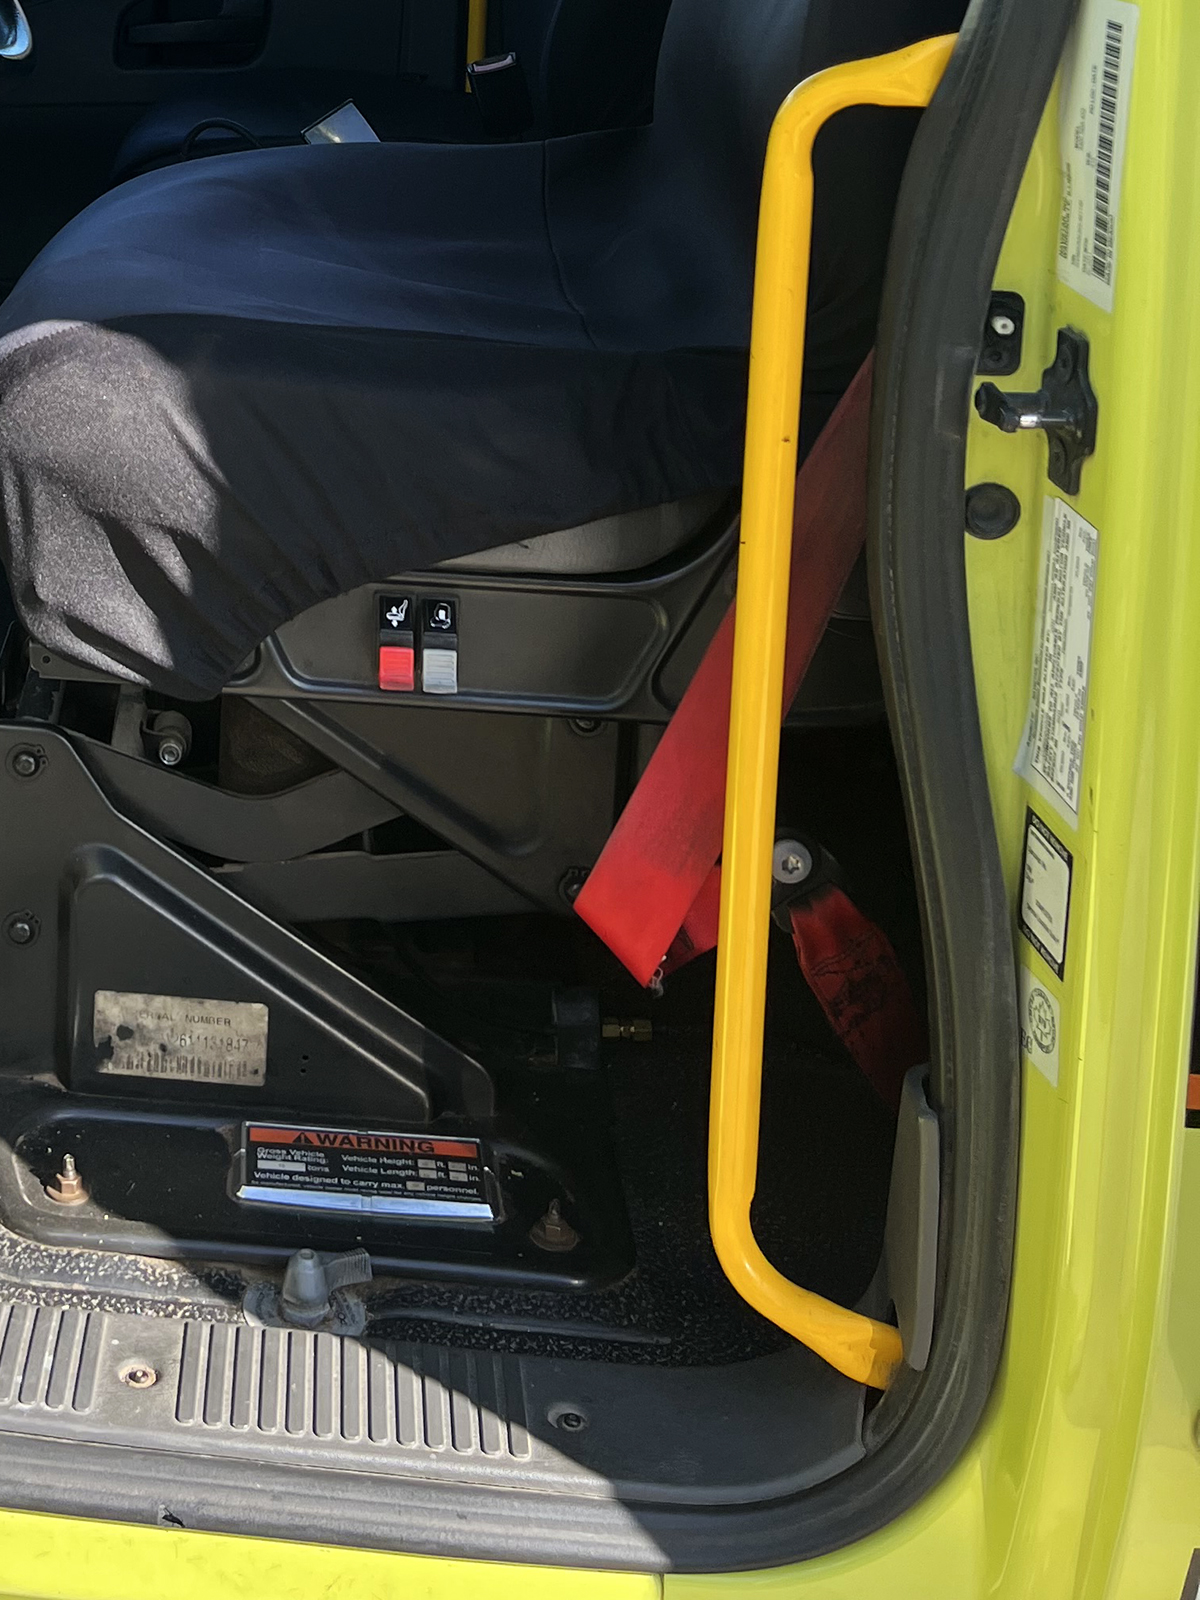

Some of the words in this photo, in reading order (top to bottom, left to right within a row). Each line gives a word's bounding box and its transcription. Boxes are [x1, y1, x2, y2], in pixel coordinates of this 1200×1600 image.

[184, 1013, 232, 1027] NUMBER
[317, 1133, 435, 1153] WARNING
[257, 1146, 287, 1155] Gross
[289, 1148, 325, 1157] Vehicle
[341, 1154, 378, 1164] Vehicle
[380, 1156, 415, 1166] Height:
[307, 1164, 330, 1173] tons
[342, 1164, 378, 1174] Vehicle
[380, 1167, 417, 1177] Length:
[253, 1171, 290, 1180] Vehicle
[292, 1173, 339, 1184] designed
[352, 1180, 379, 1188] carry
[381, 1181, 405, 1189] max.
[426, 1184, 479, 1195] personnel.
